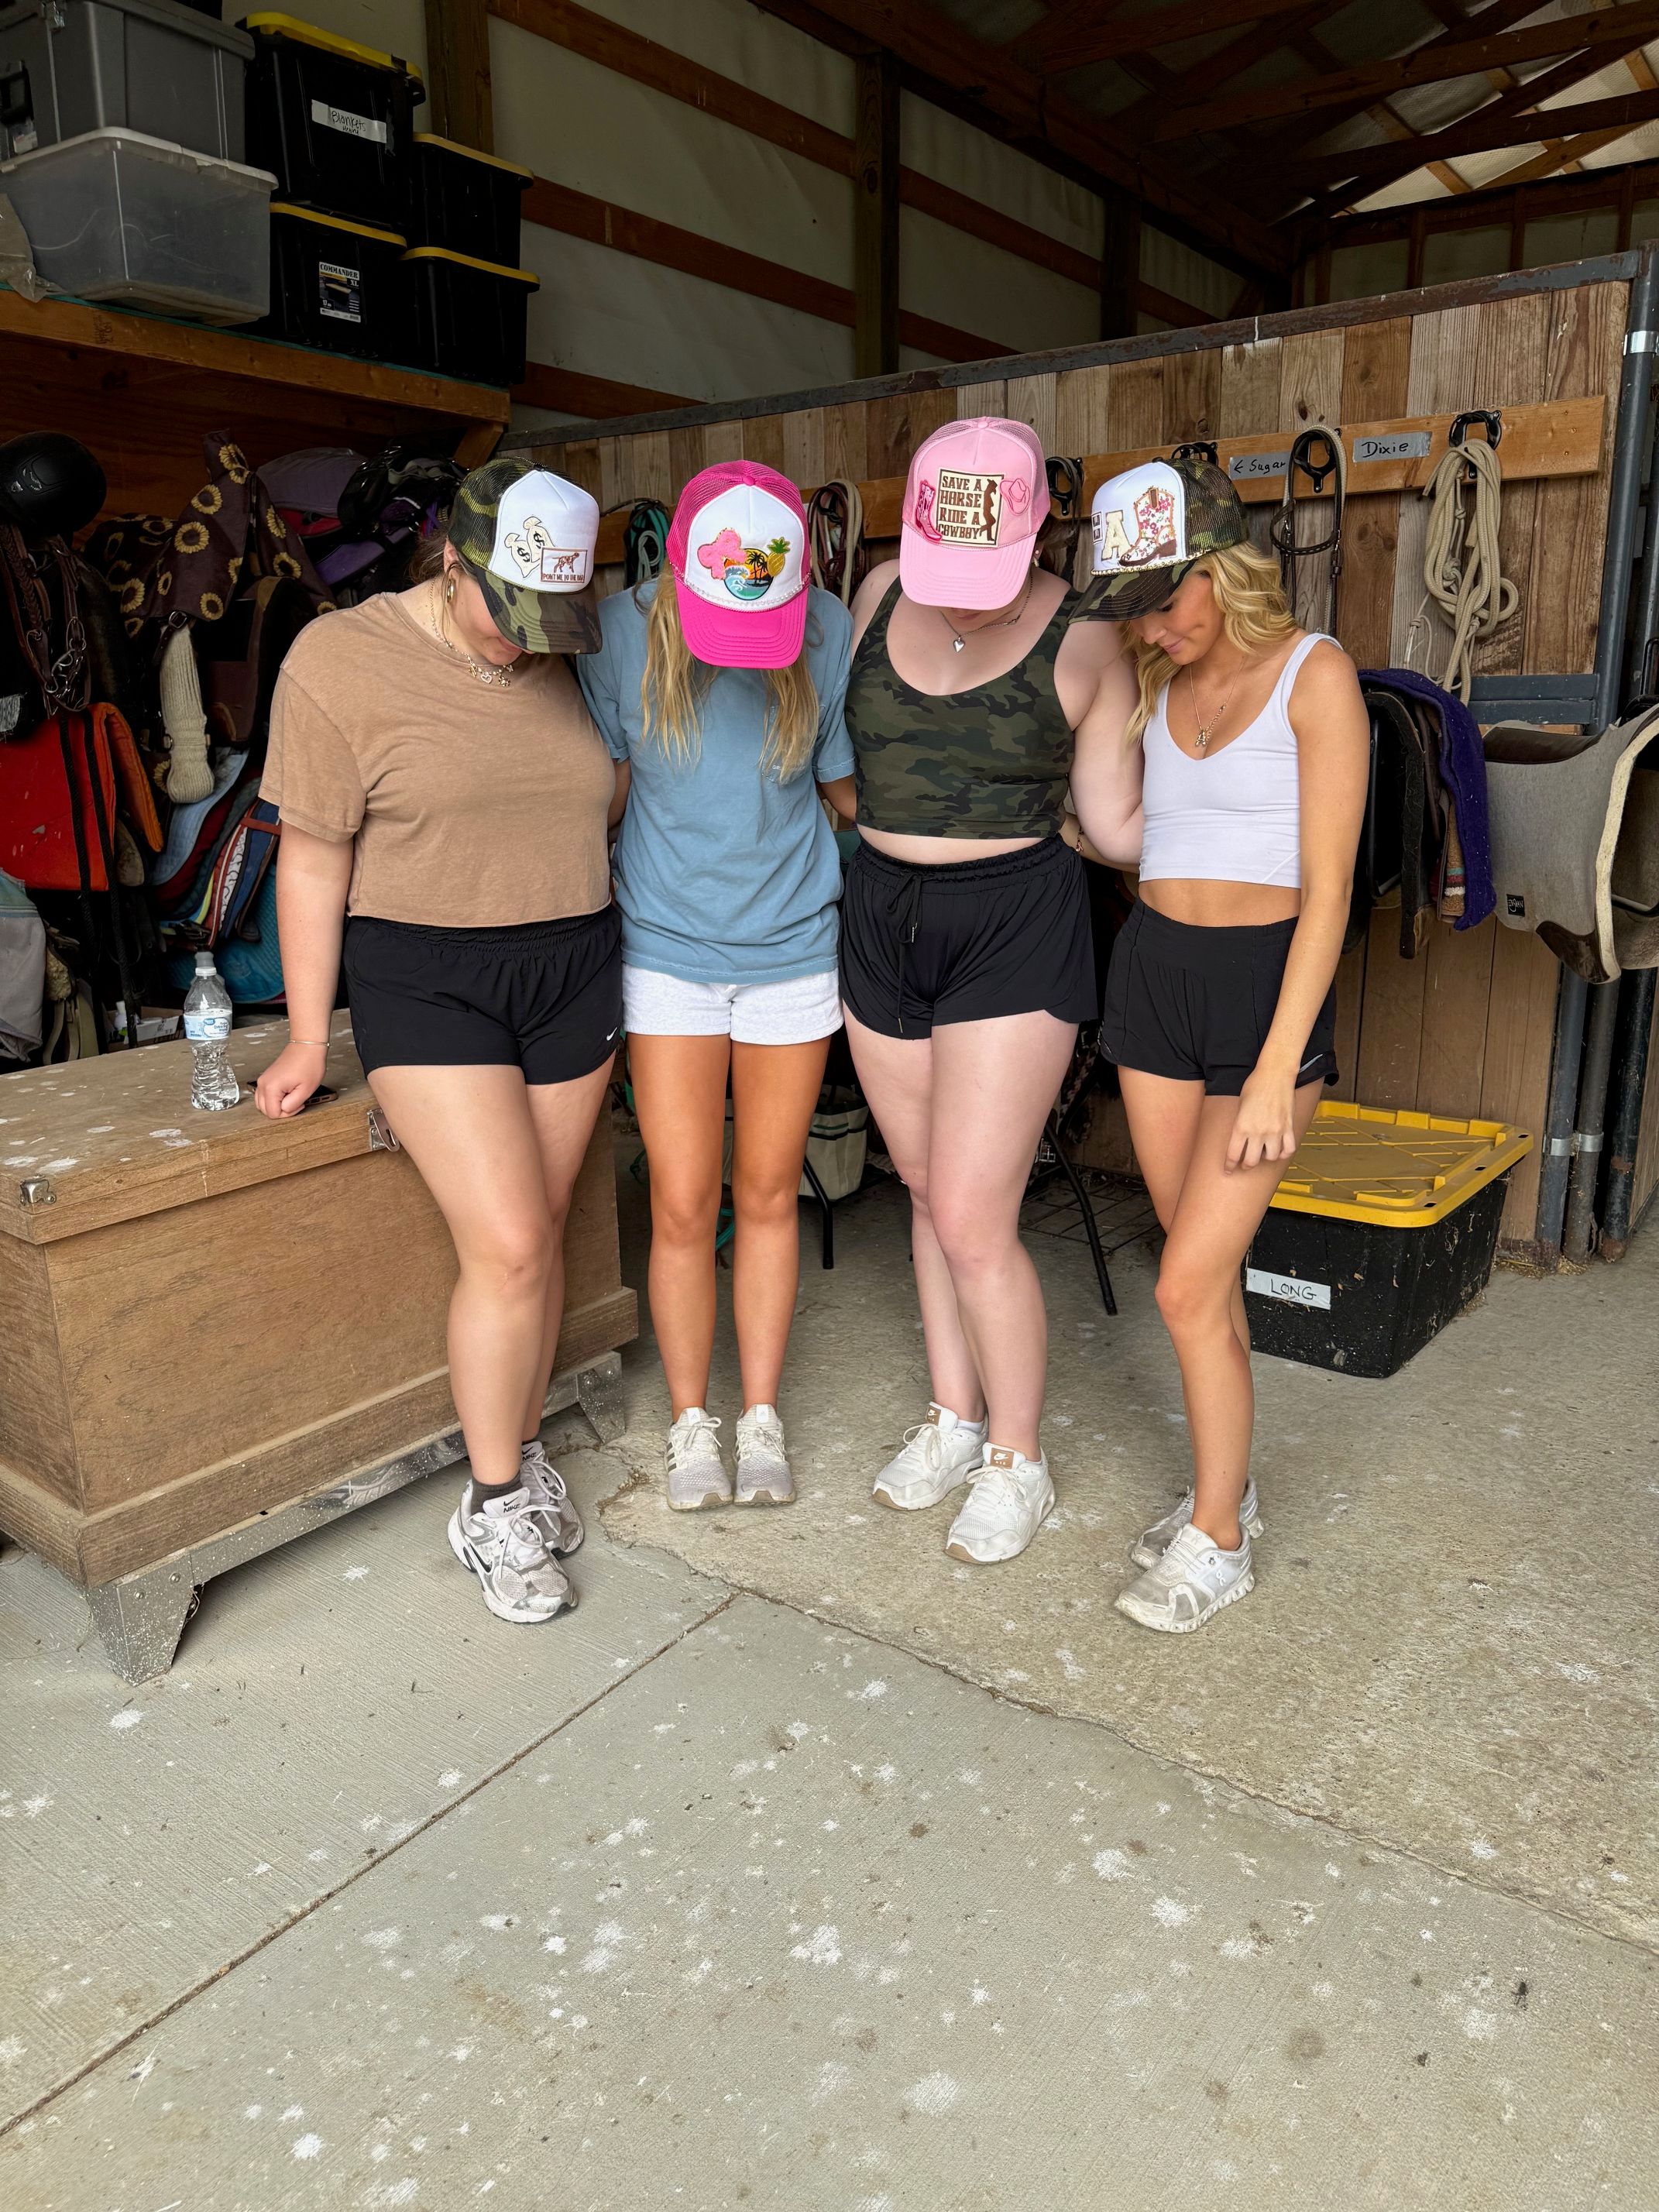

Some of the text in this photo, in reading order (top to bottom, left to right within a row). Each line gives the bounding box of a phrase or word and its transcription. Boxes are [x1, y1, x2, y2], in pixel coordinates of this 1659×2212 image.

[331, 110, 366, 132] Blankets
[320, 263, 359, 279] COMMANDER
[1361, 441, 1409, 459] Dixie
[1249, 459, 1286, 475] Sugar
[942, 476, 983, 492] SAVE A
[939, 489, 982, 508] HORSE
[939, 507, 981, 526] RIDE A
[938, 524, 981, 540] COWBOY
[1101, 510, 1132, 562] A
[1271, 1279, 1317, 1300] LONG
[503, 1503, 521, 1513] NIKE
